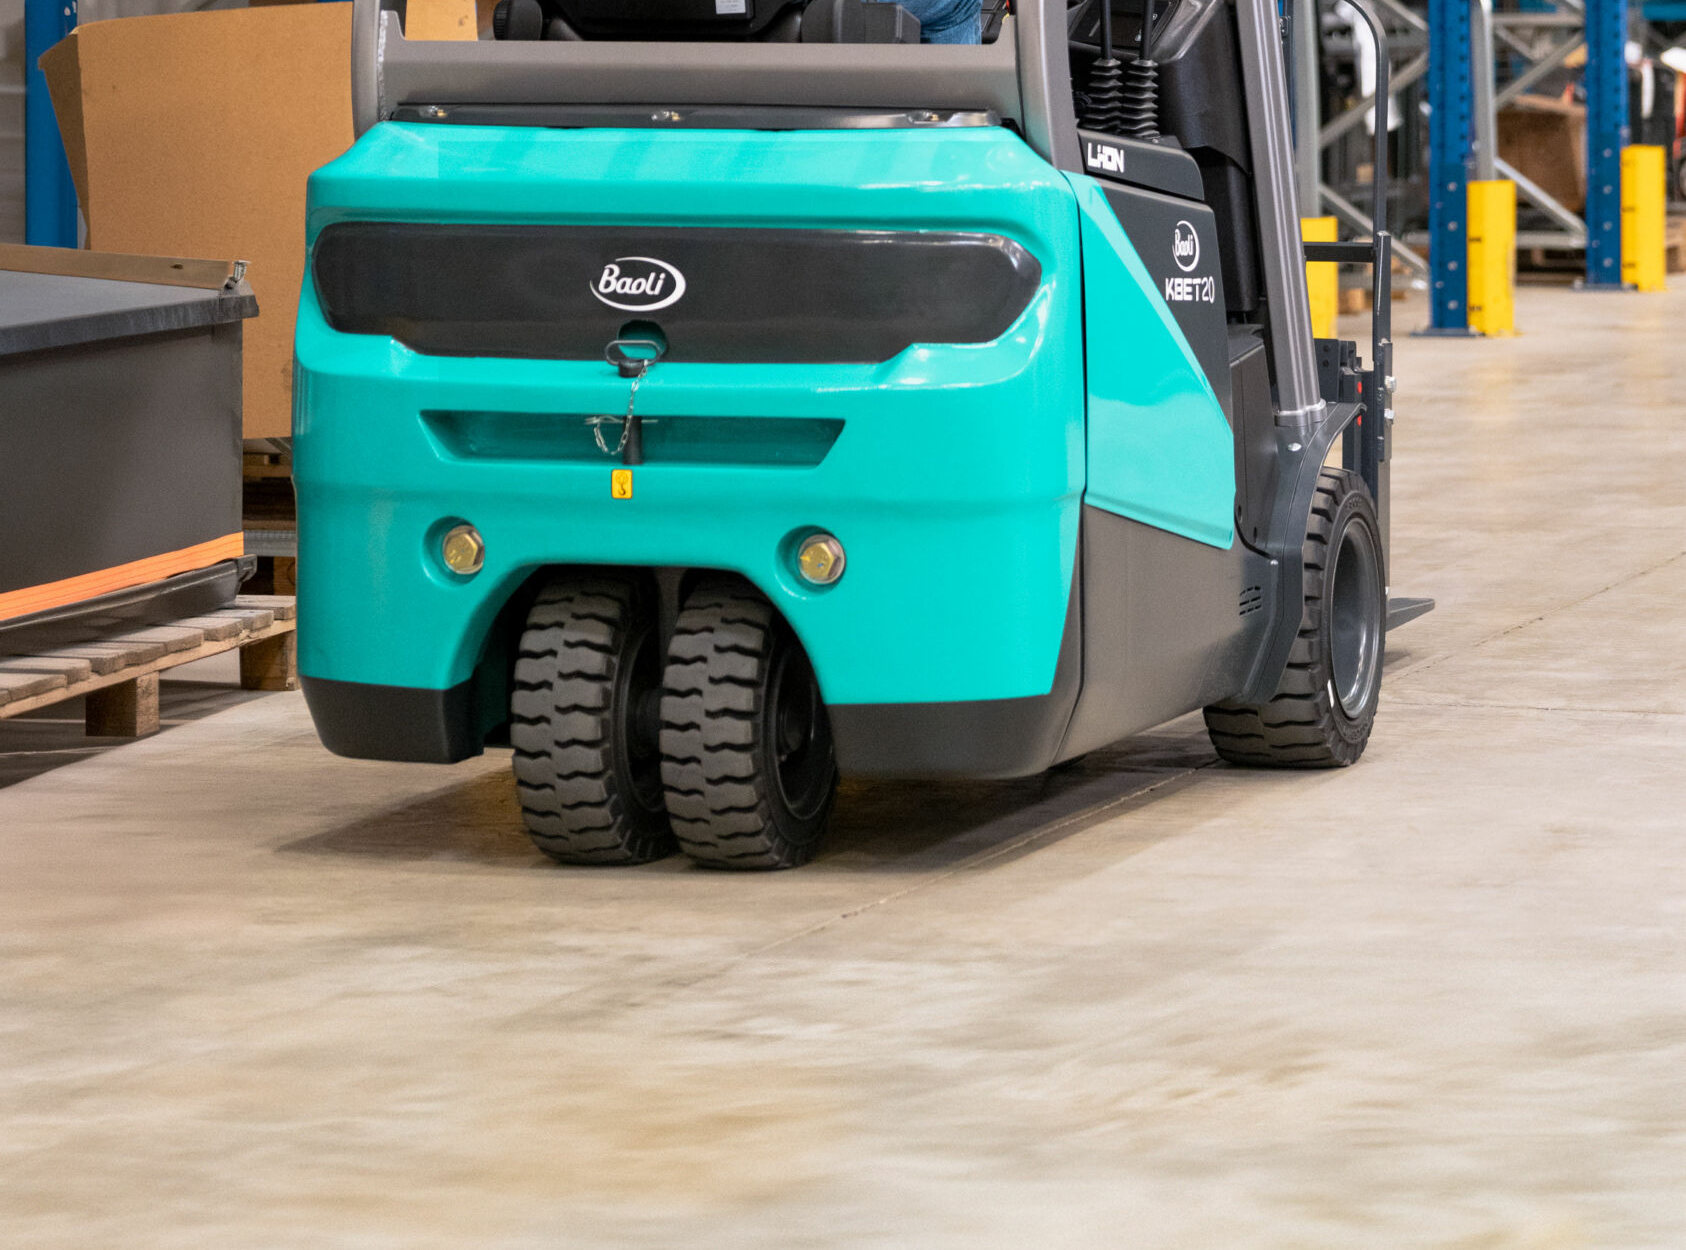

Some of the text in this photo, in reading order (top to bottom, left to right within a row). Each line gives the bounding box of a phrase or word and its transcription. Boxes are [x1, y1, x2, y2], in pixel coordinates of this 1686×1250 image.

[1174, 228, 1194, 257] Baoli
[598, 263, 666, 295] Baoli
[1165, 277, 1215, 304] KBET20
